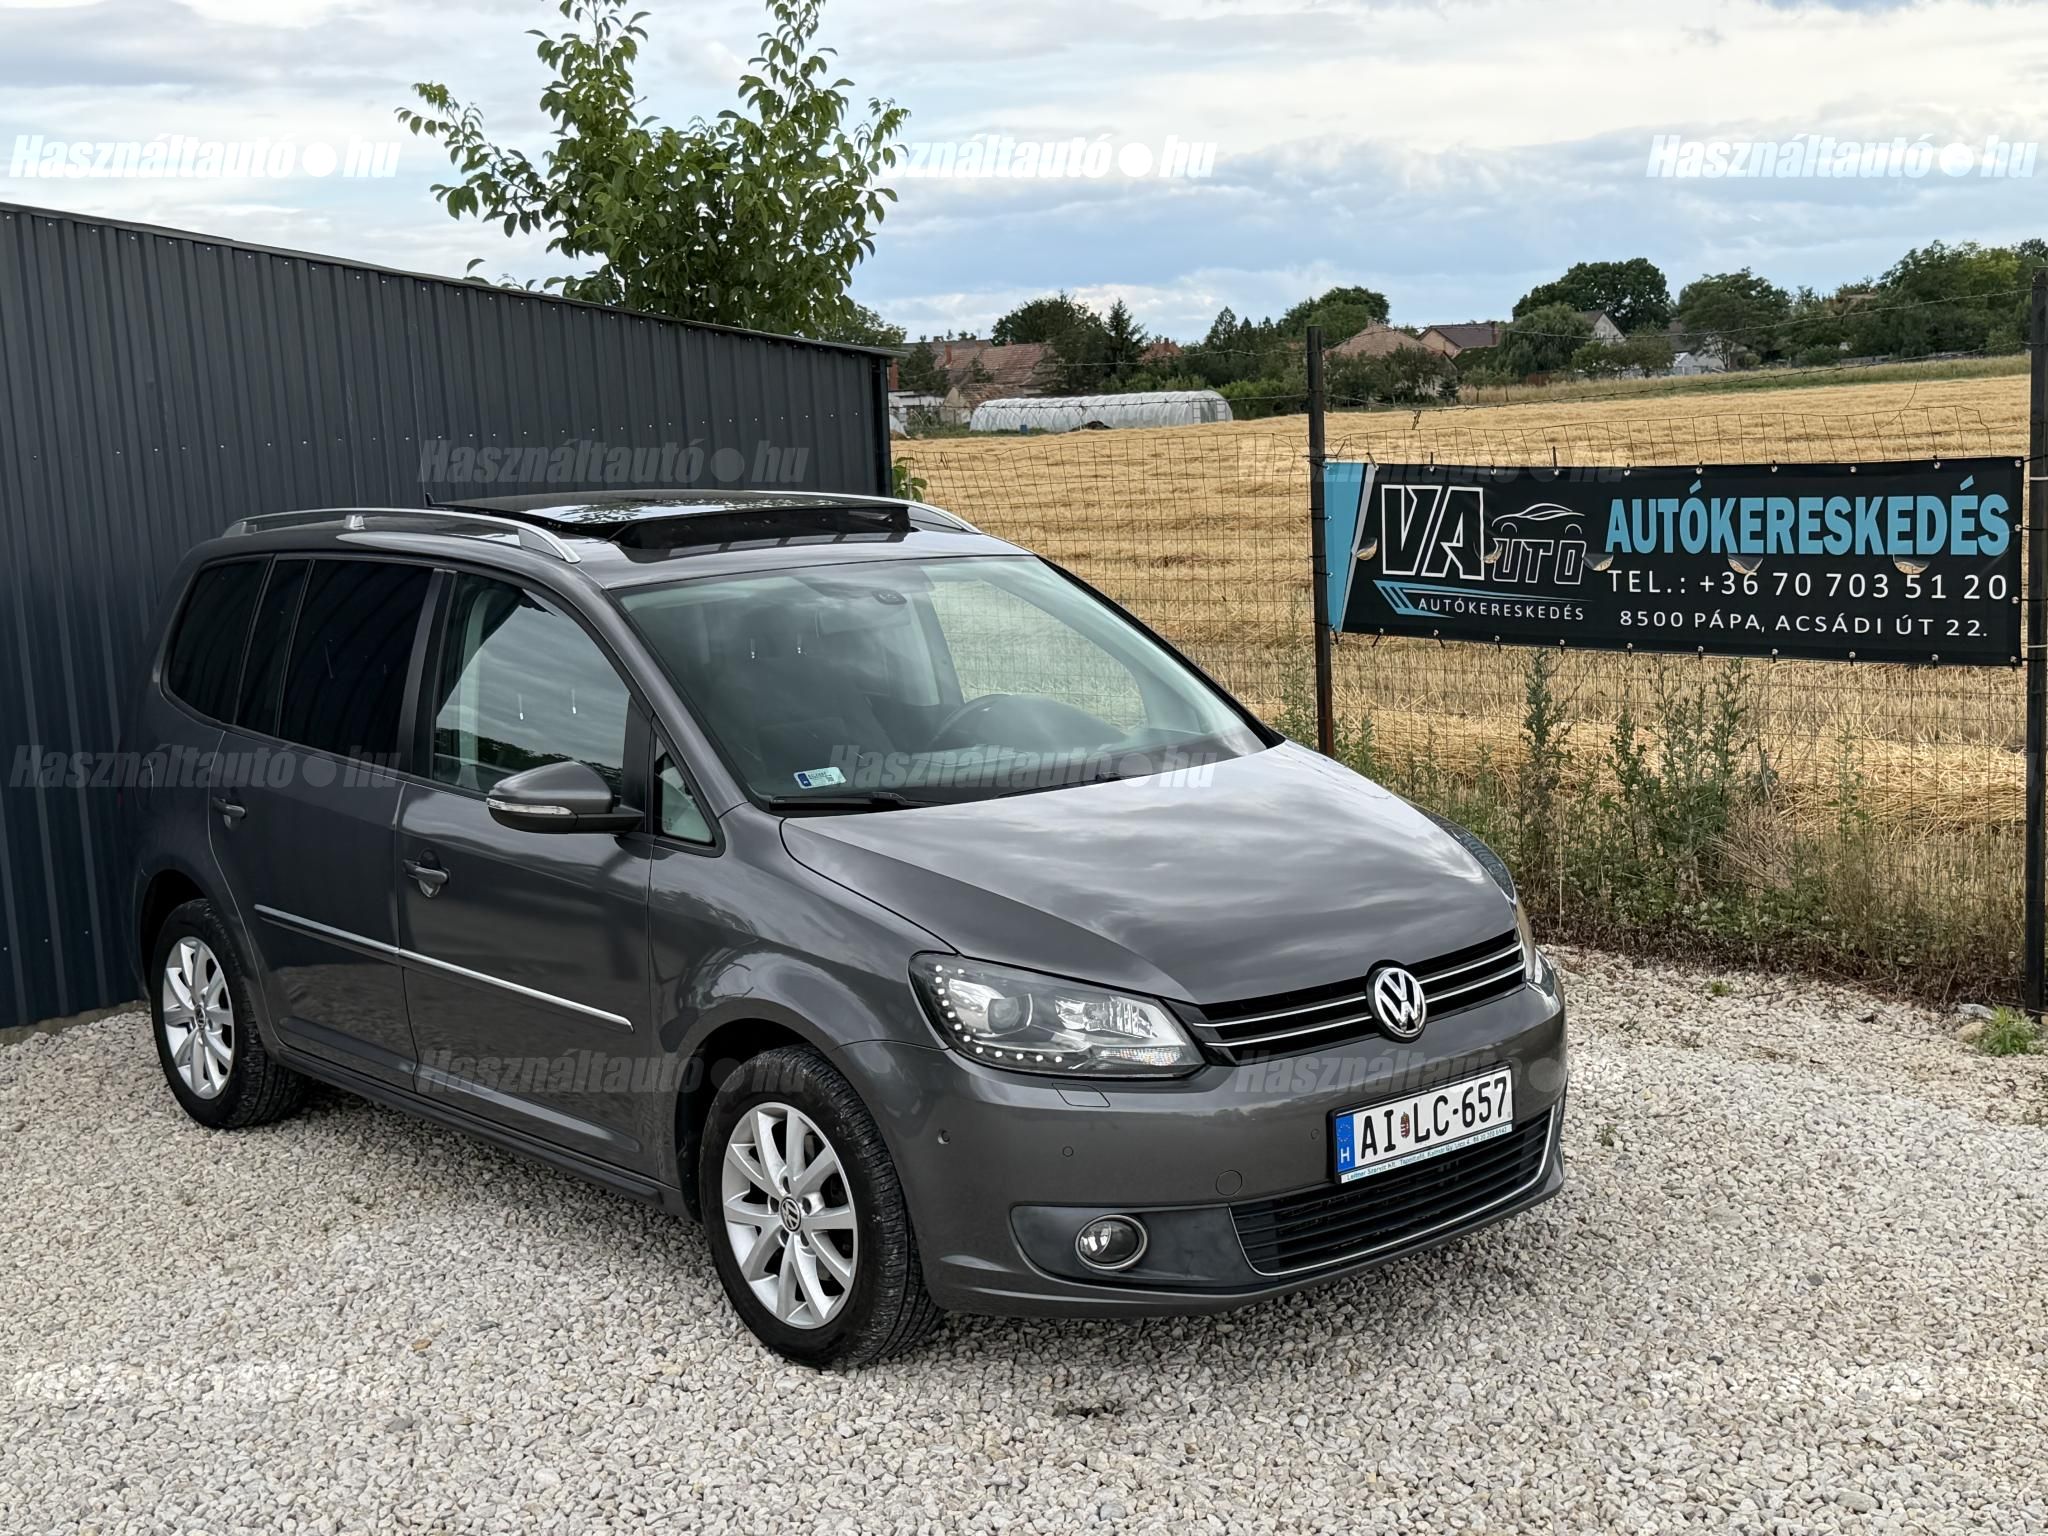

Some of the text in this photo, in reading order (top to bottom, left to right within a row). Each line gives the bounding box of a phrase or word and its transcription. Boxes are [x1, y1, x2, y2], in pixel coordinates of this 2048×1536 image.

[1605, 475, 2010, 557] AUTÓKERESKEDÉS
[1607, 570, 2007, 600] TEL.: +36 70 703 51 20
[1418, 597, 1584, 621] AUTÓKERESKEDÉS
[1619, 609, 1988, 637] 8500 PÁPA, ACSÁDI ÚT 22.
